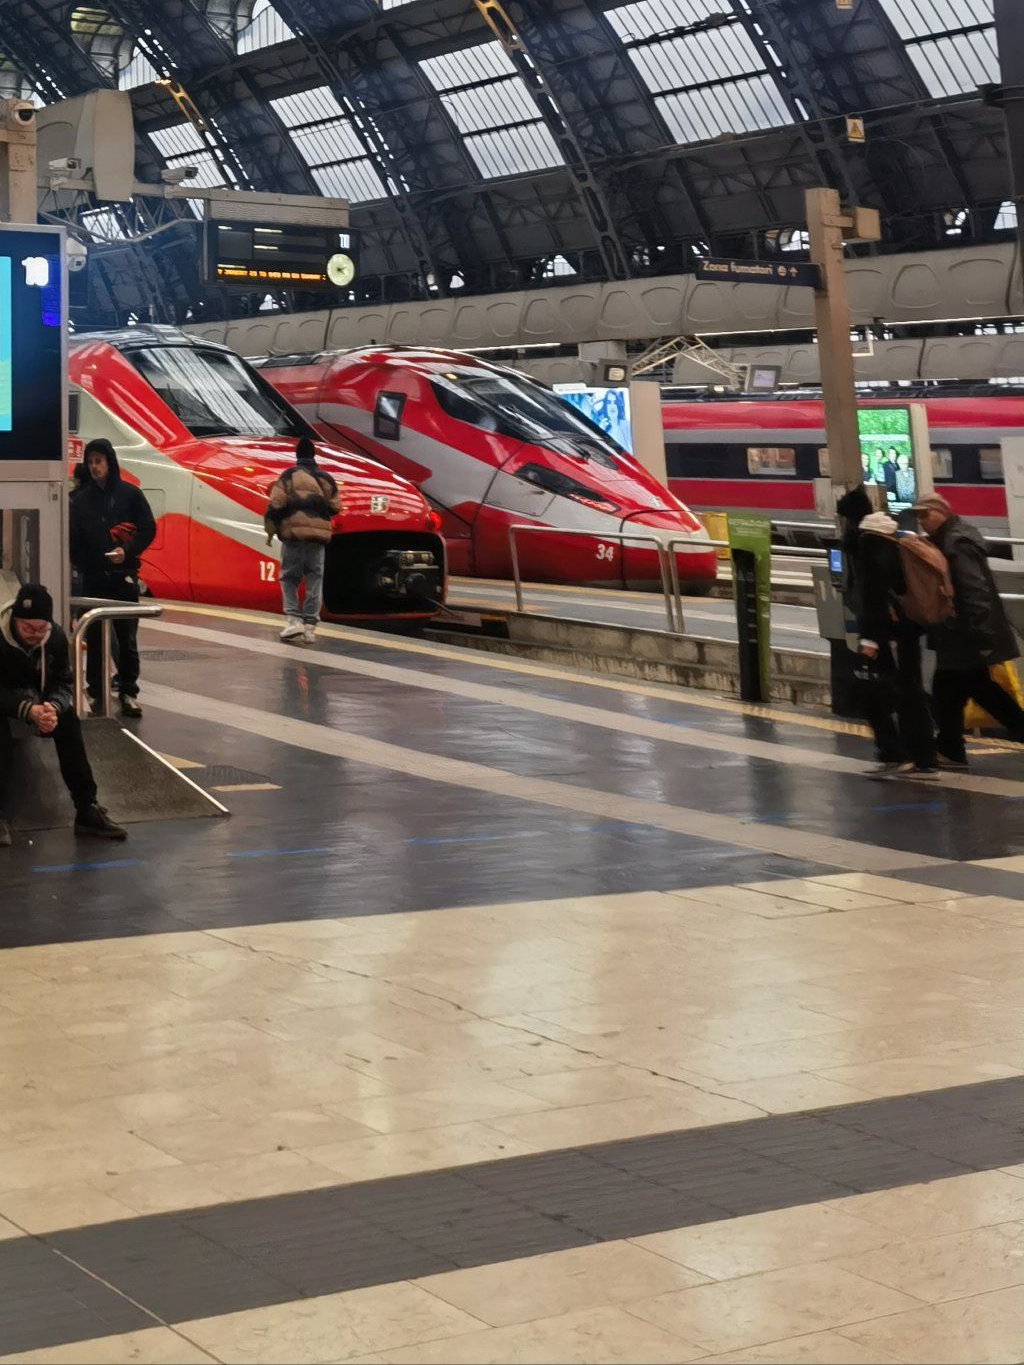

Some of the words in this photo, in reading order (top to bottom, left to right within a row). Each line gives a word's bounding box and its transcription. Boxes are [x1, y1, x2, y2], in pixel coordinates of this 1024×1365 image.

[21, 256, 49, 286] 10
[702, 260, 729, 272] Zona
[596, 543, 614, 562] 34
[259, 560, 276, 582] 12
